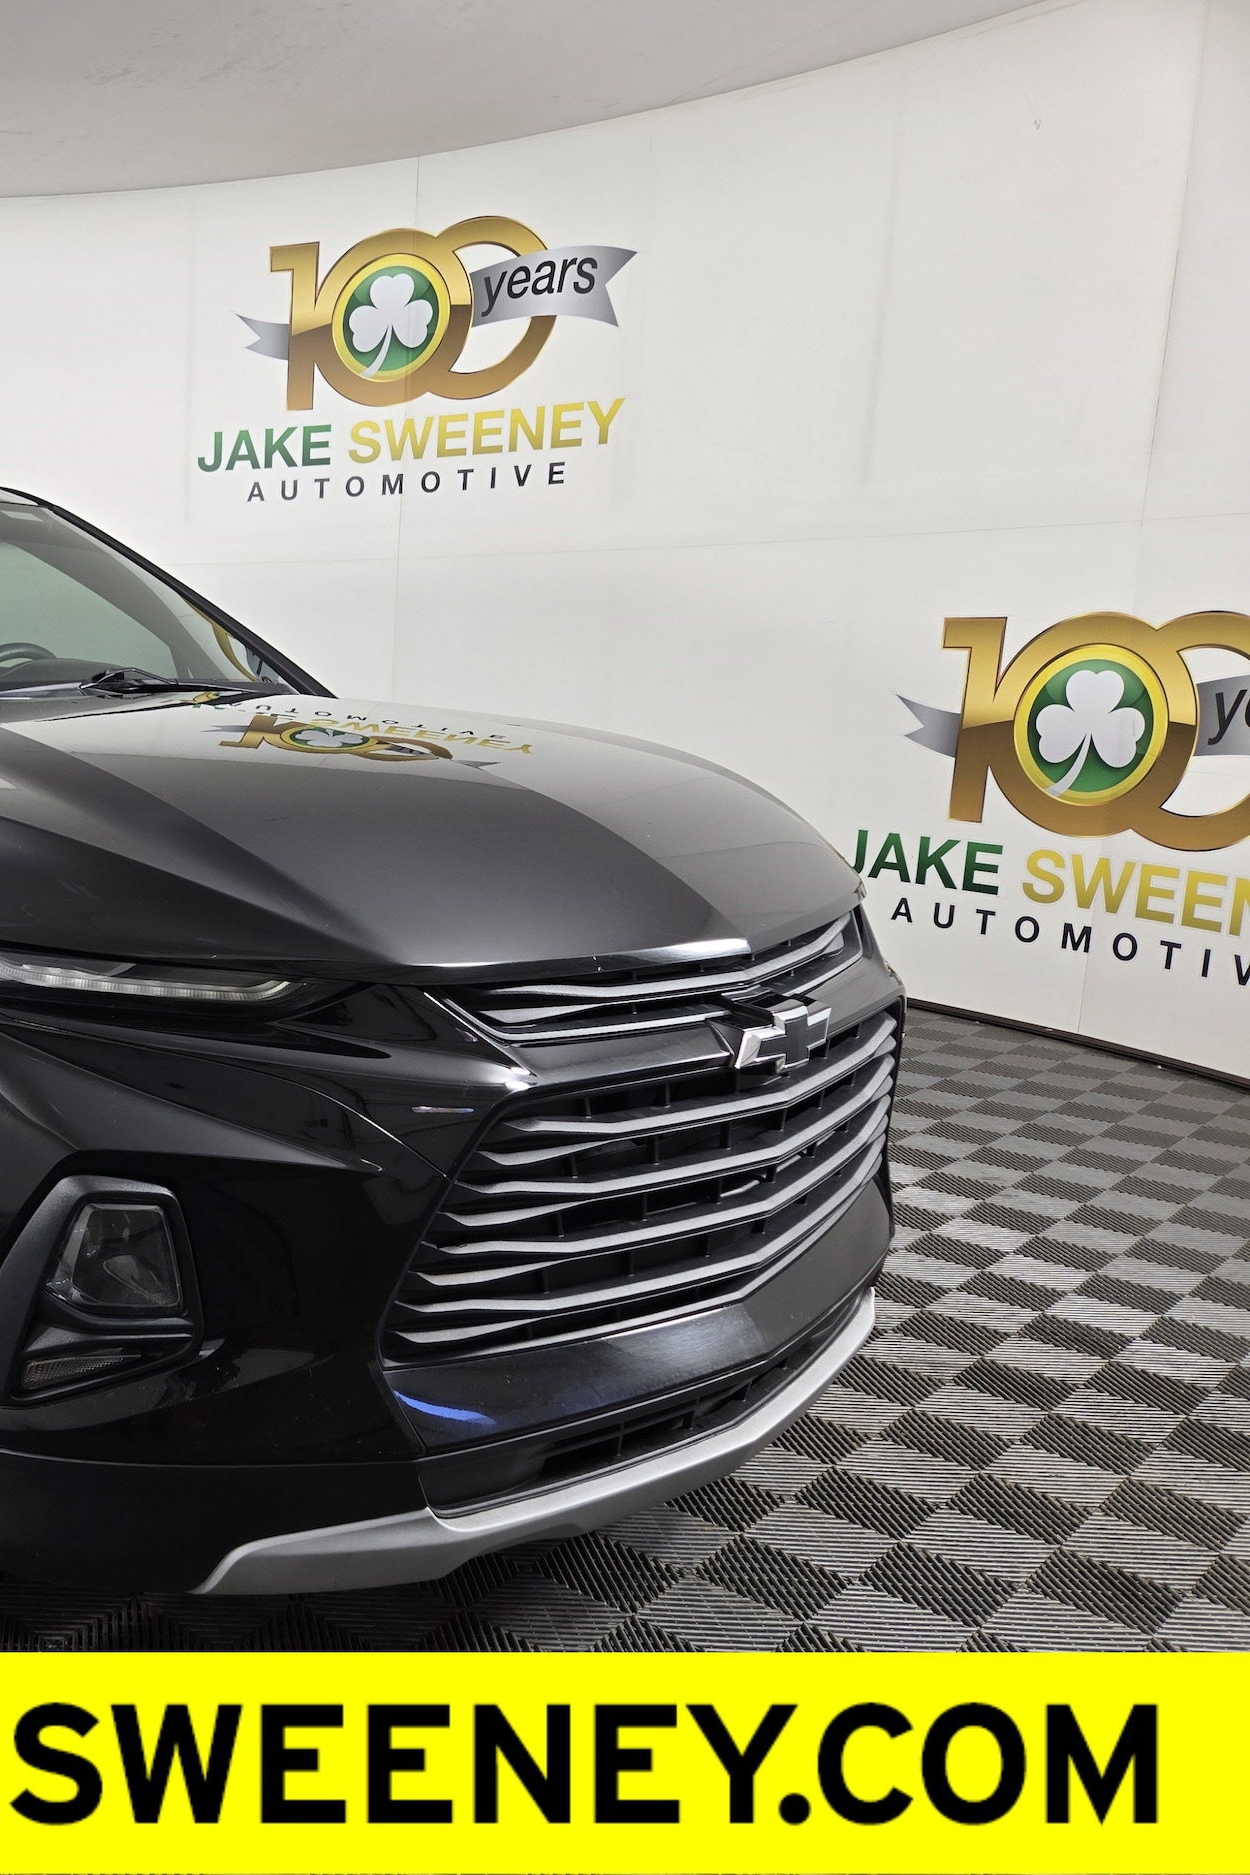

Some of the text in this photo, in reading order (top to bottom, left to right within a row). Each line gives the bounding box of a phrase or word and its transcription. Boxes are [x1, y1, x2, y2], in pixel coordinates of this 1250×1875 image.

[481, 257, 598, 317] years
[197, 397, 626, 473] JAKE SWEENEY
[246, 461, 566, 503] AUTOMOTIVE
[852, 828, 1005, 897] JAKE
